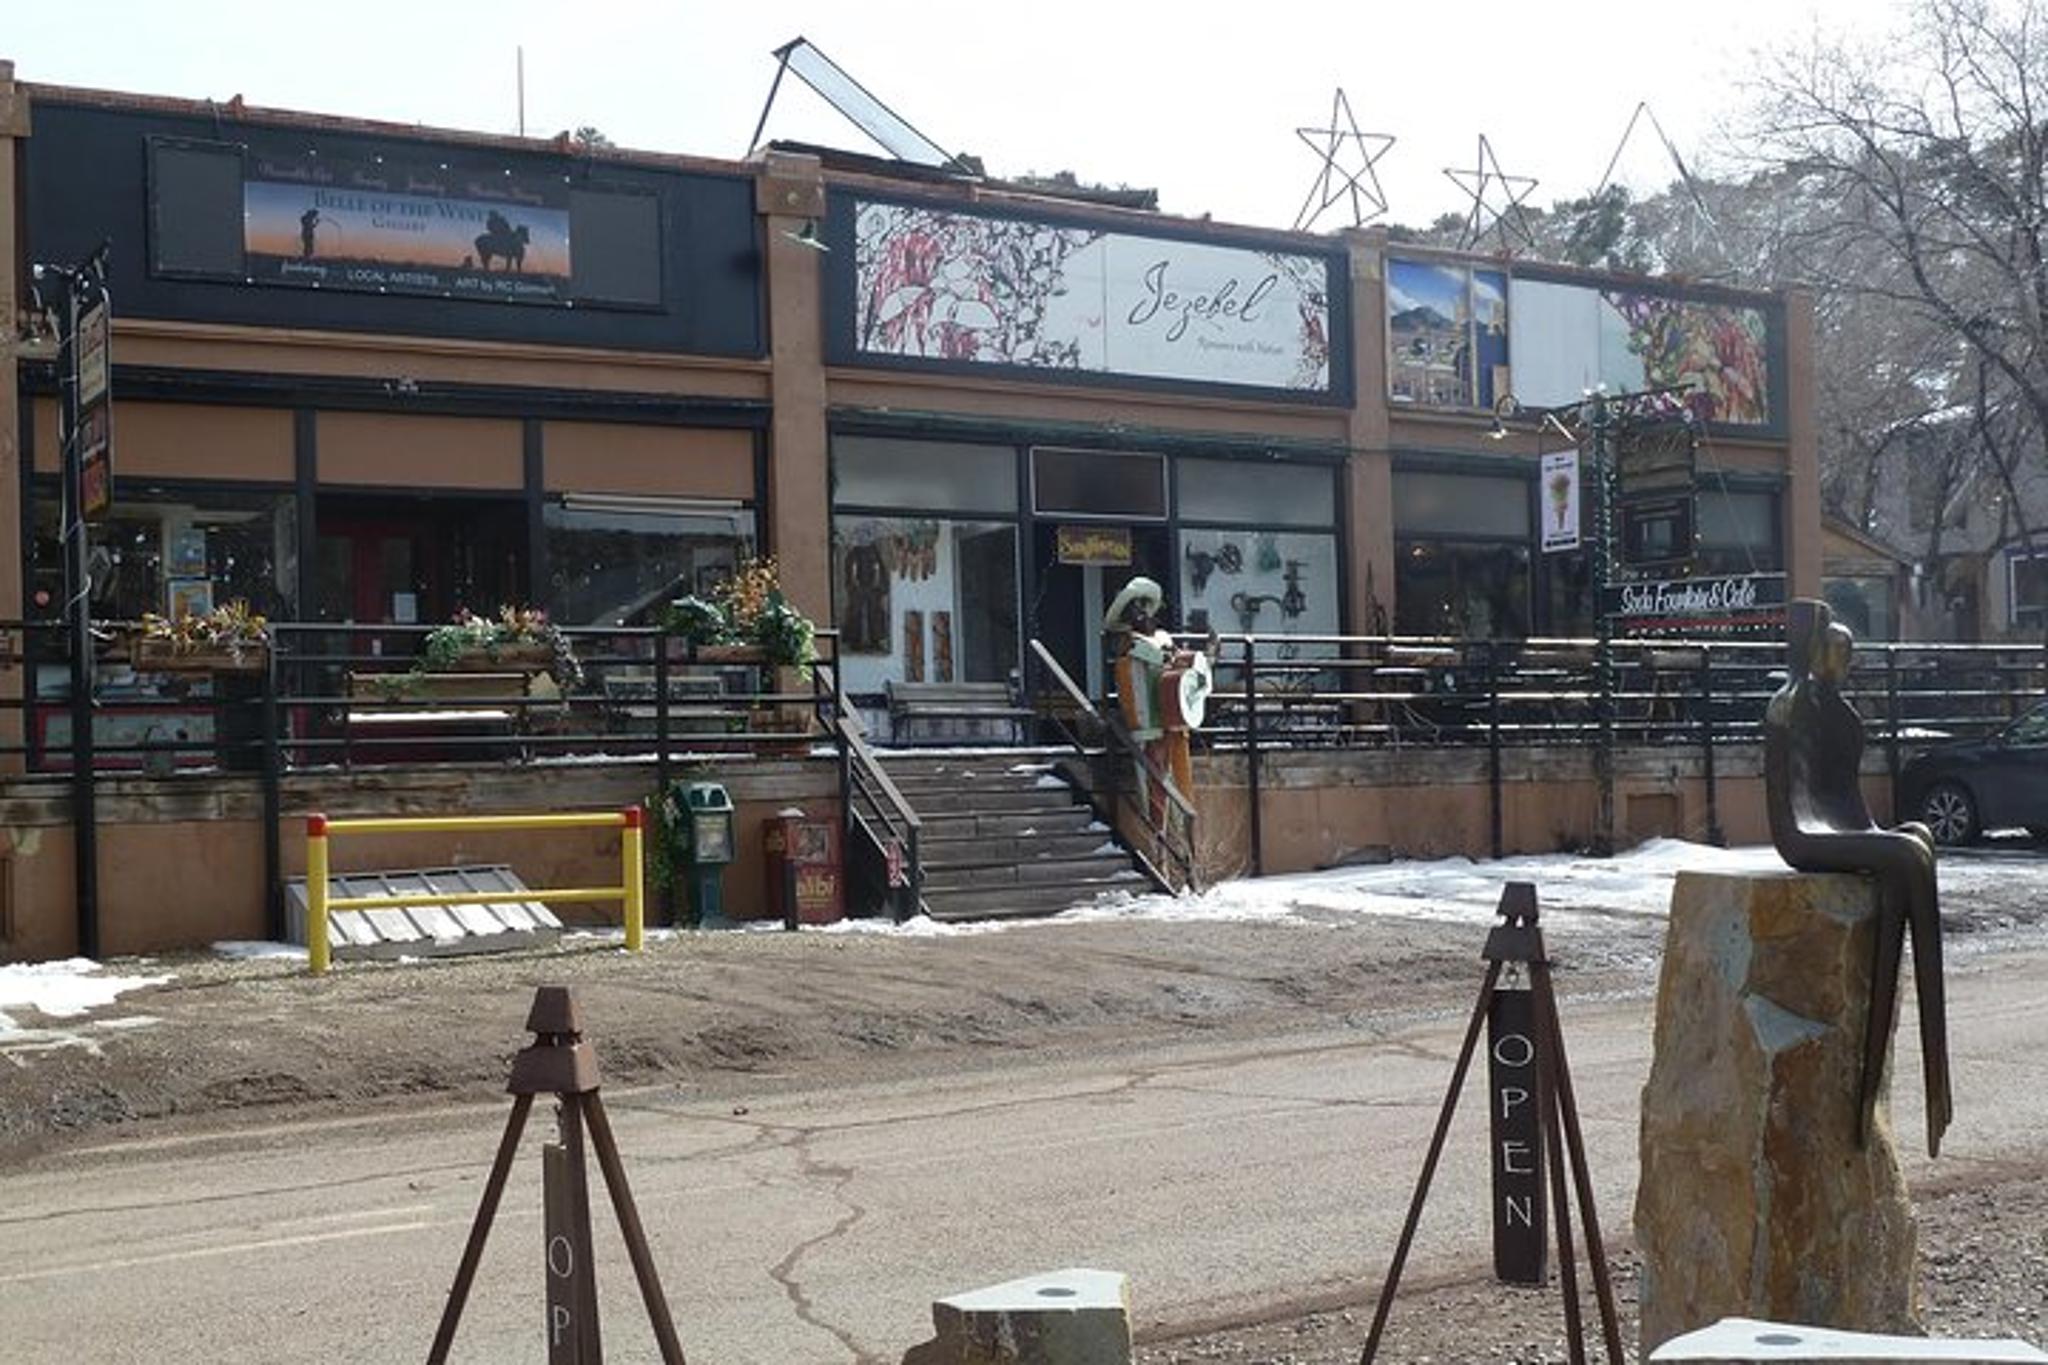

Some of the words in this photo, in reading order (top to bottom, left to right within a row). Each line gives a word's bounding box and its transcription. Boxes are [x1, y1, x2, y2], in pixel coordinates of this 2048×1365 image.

[313, 188, 366, 212] BELLE
[370, 199, 393, 215] OF
[398, 201, 433, 218] THE
[435, 201, 484, 223] WEST
[347, 267, 386, 284] LOCAL
[388, 271, 438, 288] ARTISTS
[454, 275, 479, 291] ART
[1127, 260, 1278, 342] Jezebel
[1620, 583, 1654, 615] Soda
[1655, 582, 1707, 613] Fountain
[1708, 581, 1720, 608] &
[1494, 1034, 1533, 1228] OPEN
